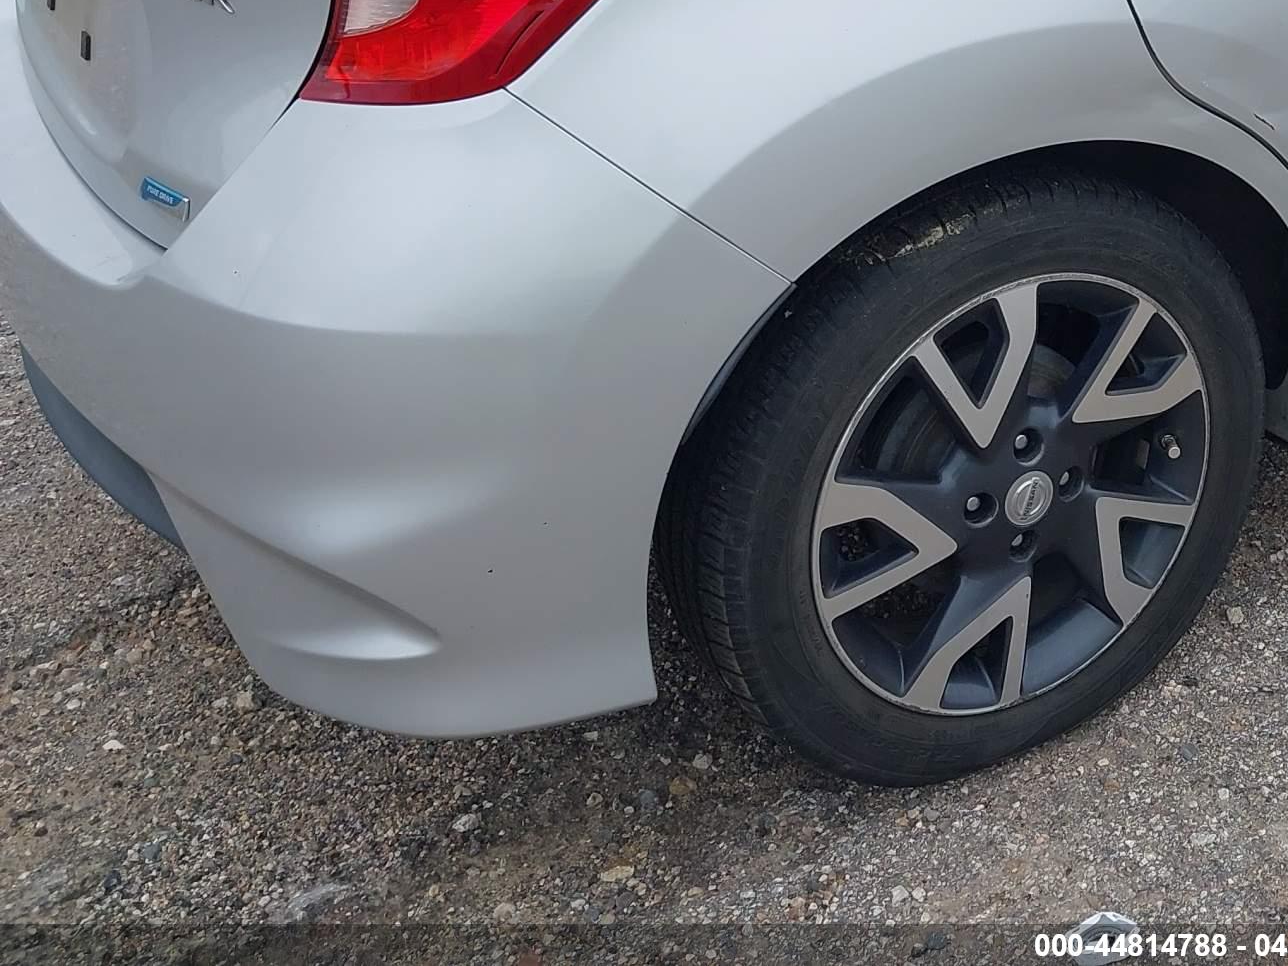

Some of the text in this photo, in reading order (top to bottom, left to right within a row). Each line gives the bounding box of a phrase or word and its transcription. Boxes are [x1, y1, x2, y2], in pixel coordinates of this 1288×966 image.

[147, 185, 174, 204] PURE DRIVE
[1023, 479, 1039, 516] NISSAN
